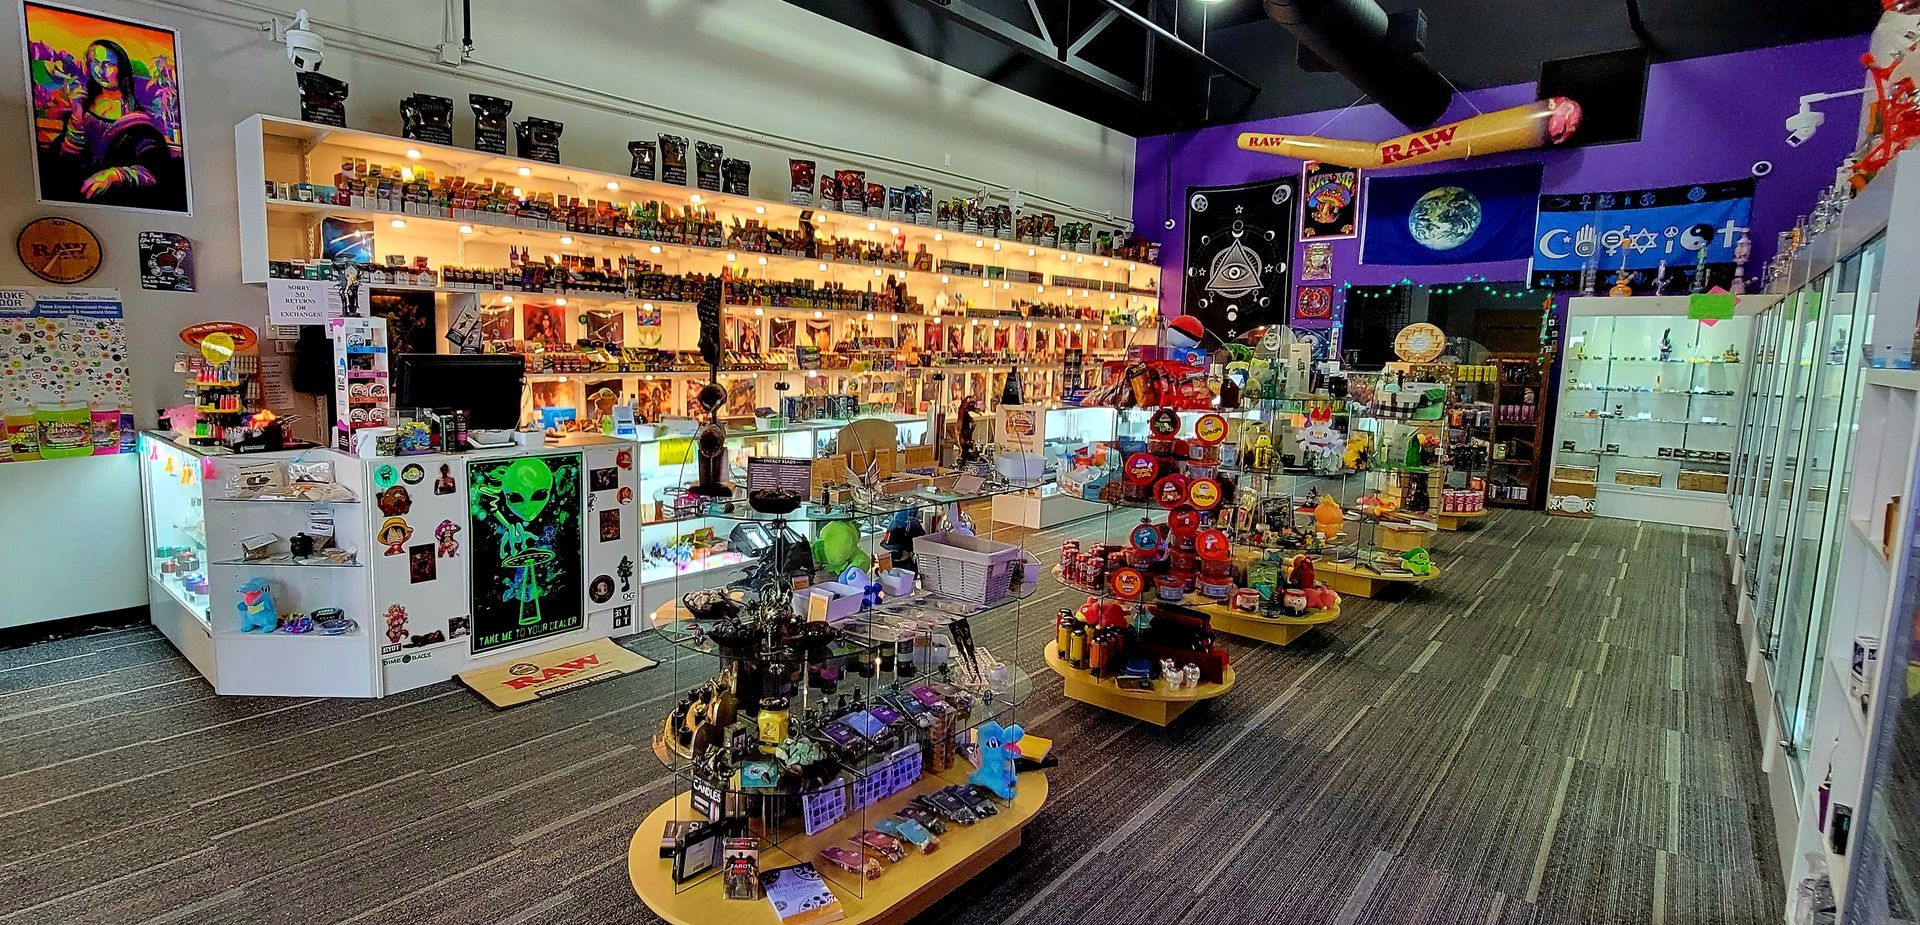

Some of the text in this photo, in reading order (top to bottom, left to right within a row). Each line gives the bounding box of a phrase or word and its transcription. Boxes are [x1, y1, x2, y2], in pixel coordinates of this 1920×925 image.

[1249, 136, 1285, 147] RAW
[1381, 126, 1459, 165] RAW
[1309, 171, 1355, 195] EAT ME
[622, 592, 635, 600] OG
[480, 616, 578, 646] TAKE ME TO YOUR DEALER
[382, 658, 402, 667] DIME
[500, 653, 599, 690] RAW
[693, 779, 722, 803] CANDLES
